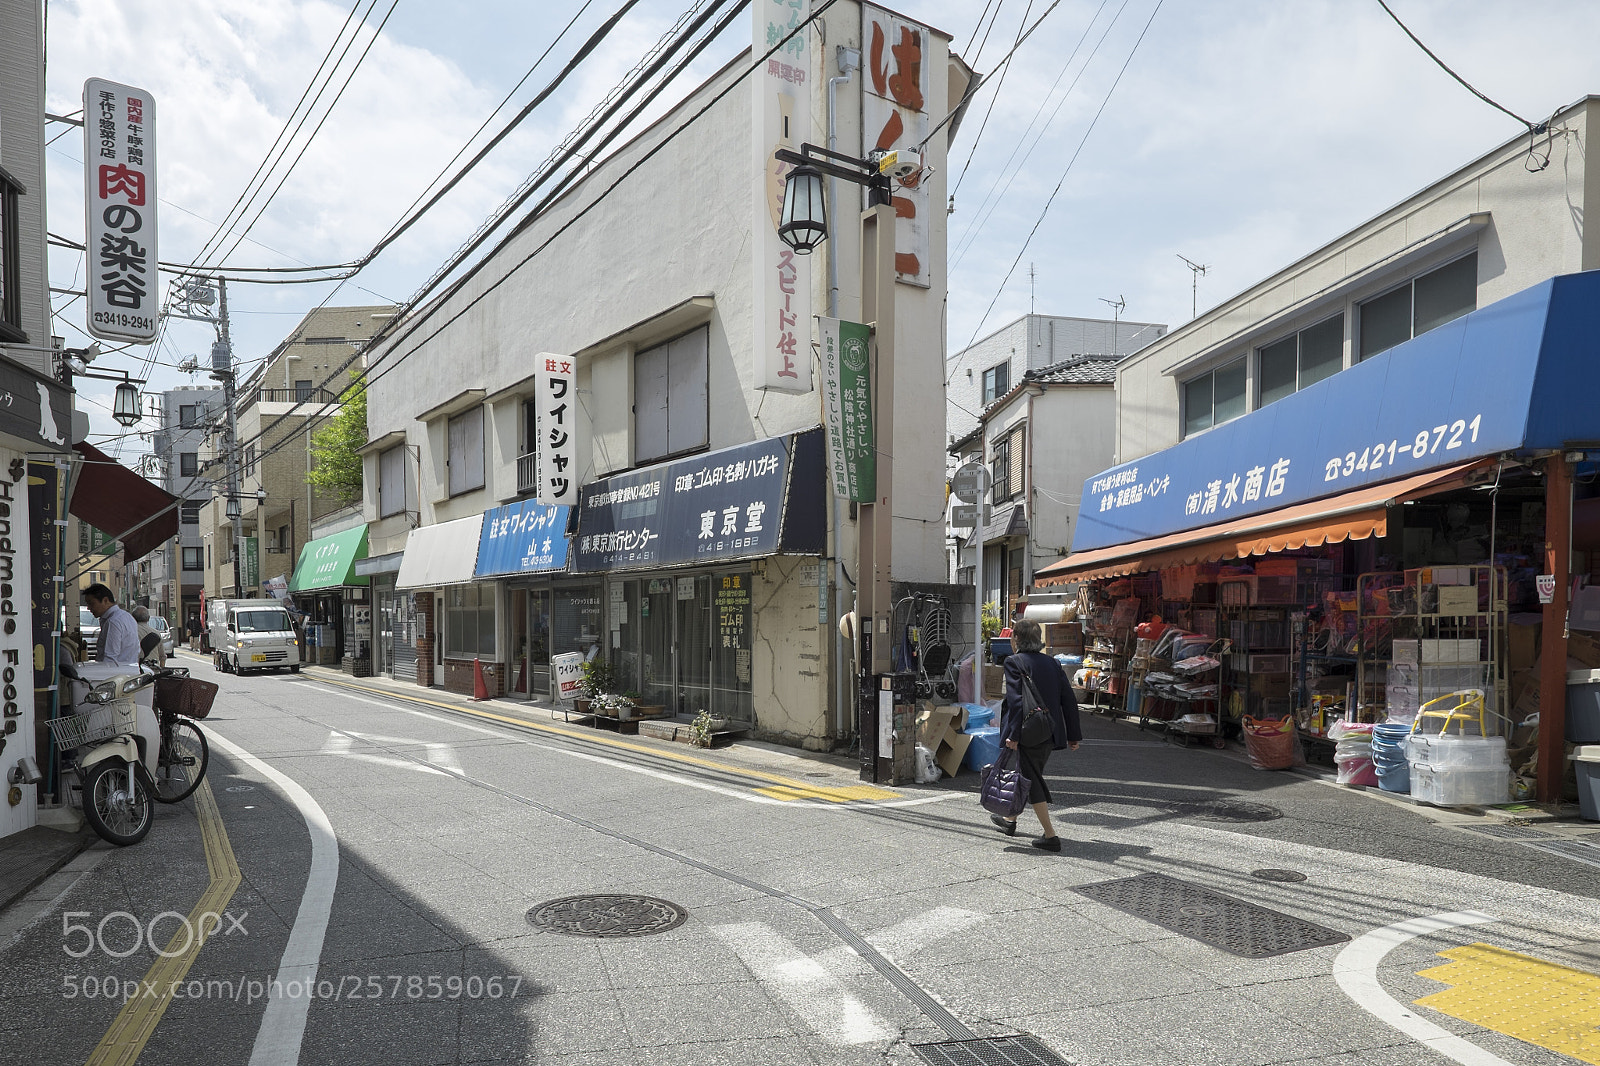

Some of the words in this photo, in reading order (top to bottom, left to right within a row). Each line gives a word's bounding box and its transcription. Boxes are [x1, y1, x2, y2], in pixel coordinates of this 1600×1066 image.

[99, 90, 117, 159] 手作り惣菜の店
[98, 163, 147, 310] 肉の染谷
[103, 311, 154, 331] 3419-2941
[776, 250, 799, 380] スピード仕上
[549, 377, 570, 499] ワイシャツ
[855, 374, 869, 458] 元気でやさしい
[1342, 413, 1482, 477] 3421-8721
[698, 500, 767, 541] 東京堂
[0, 480, 18, 636] Handmade
[722, 576, 741, 589] 印章
[720, 613, 744, 627] ゴム印
[3, 648, 23, 736] Foods
[558, 664, 584, 676] ワイシャ
